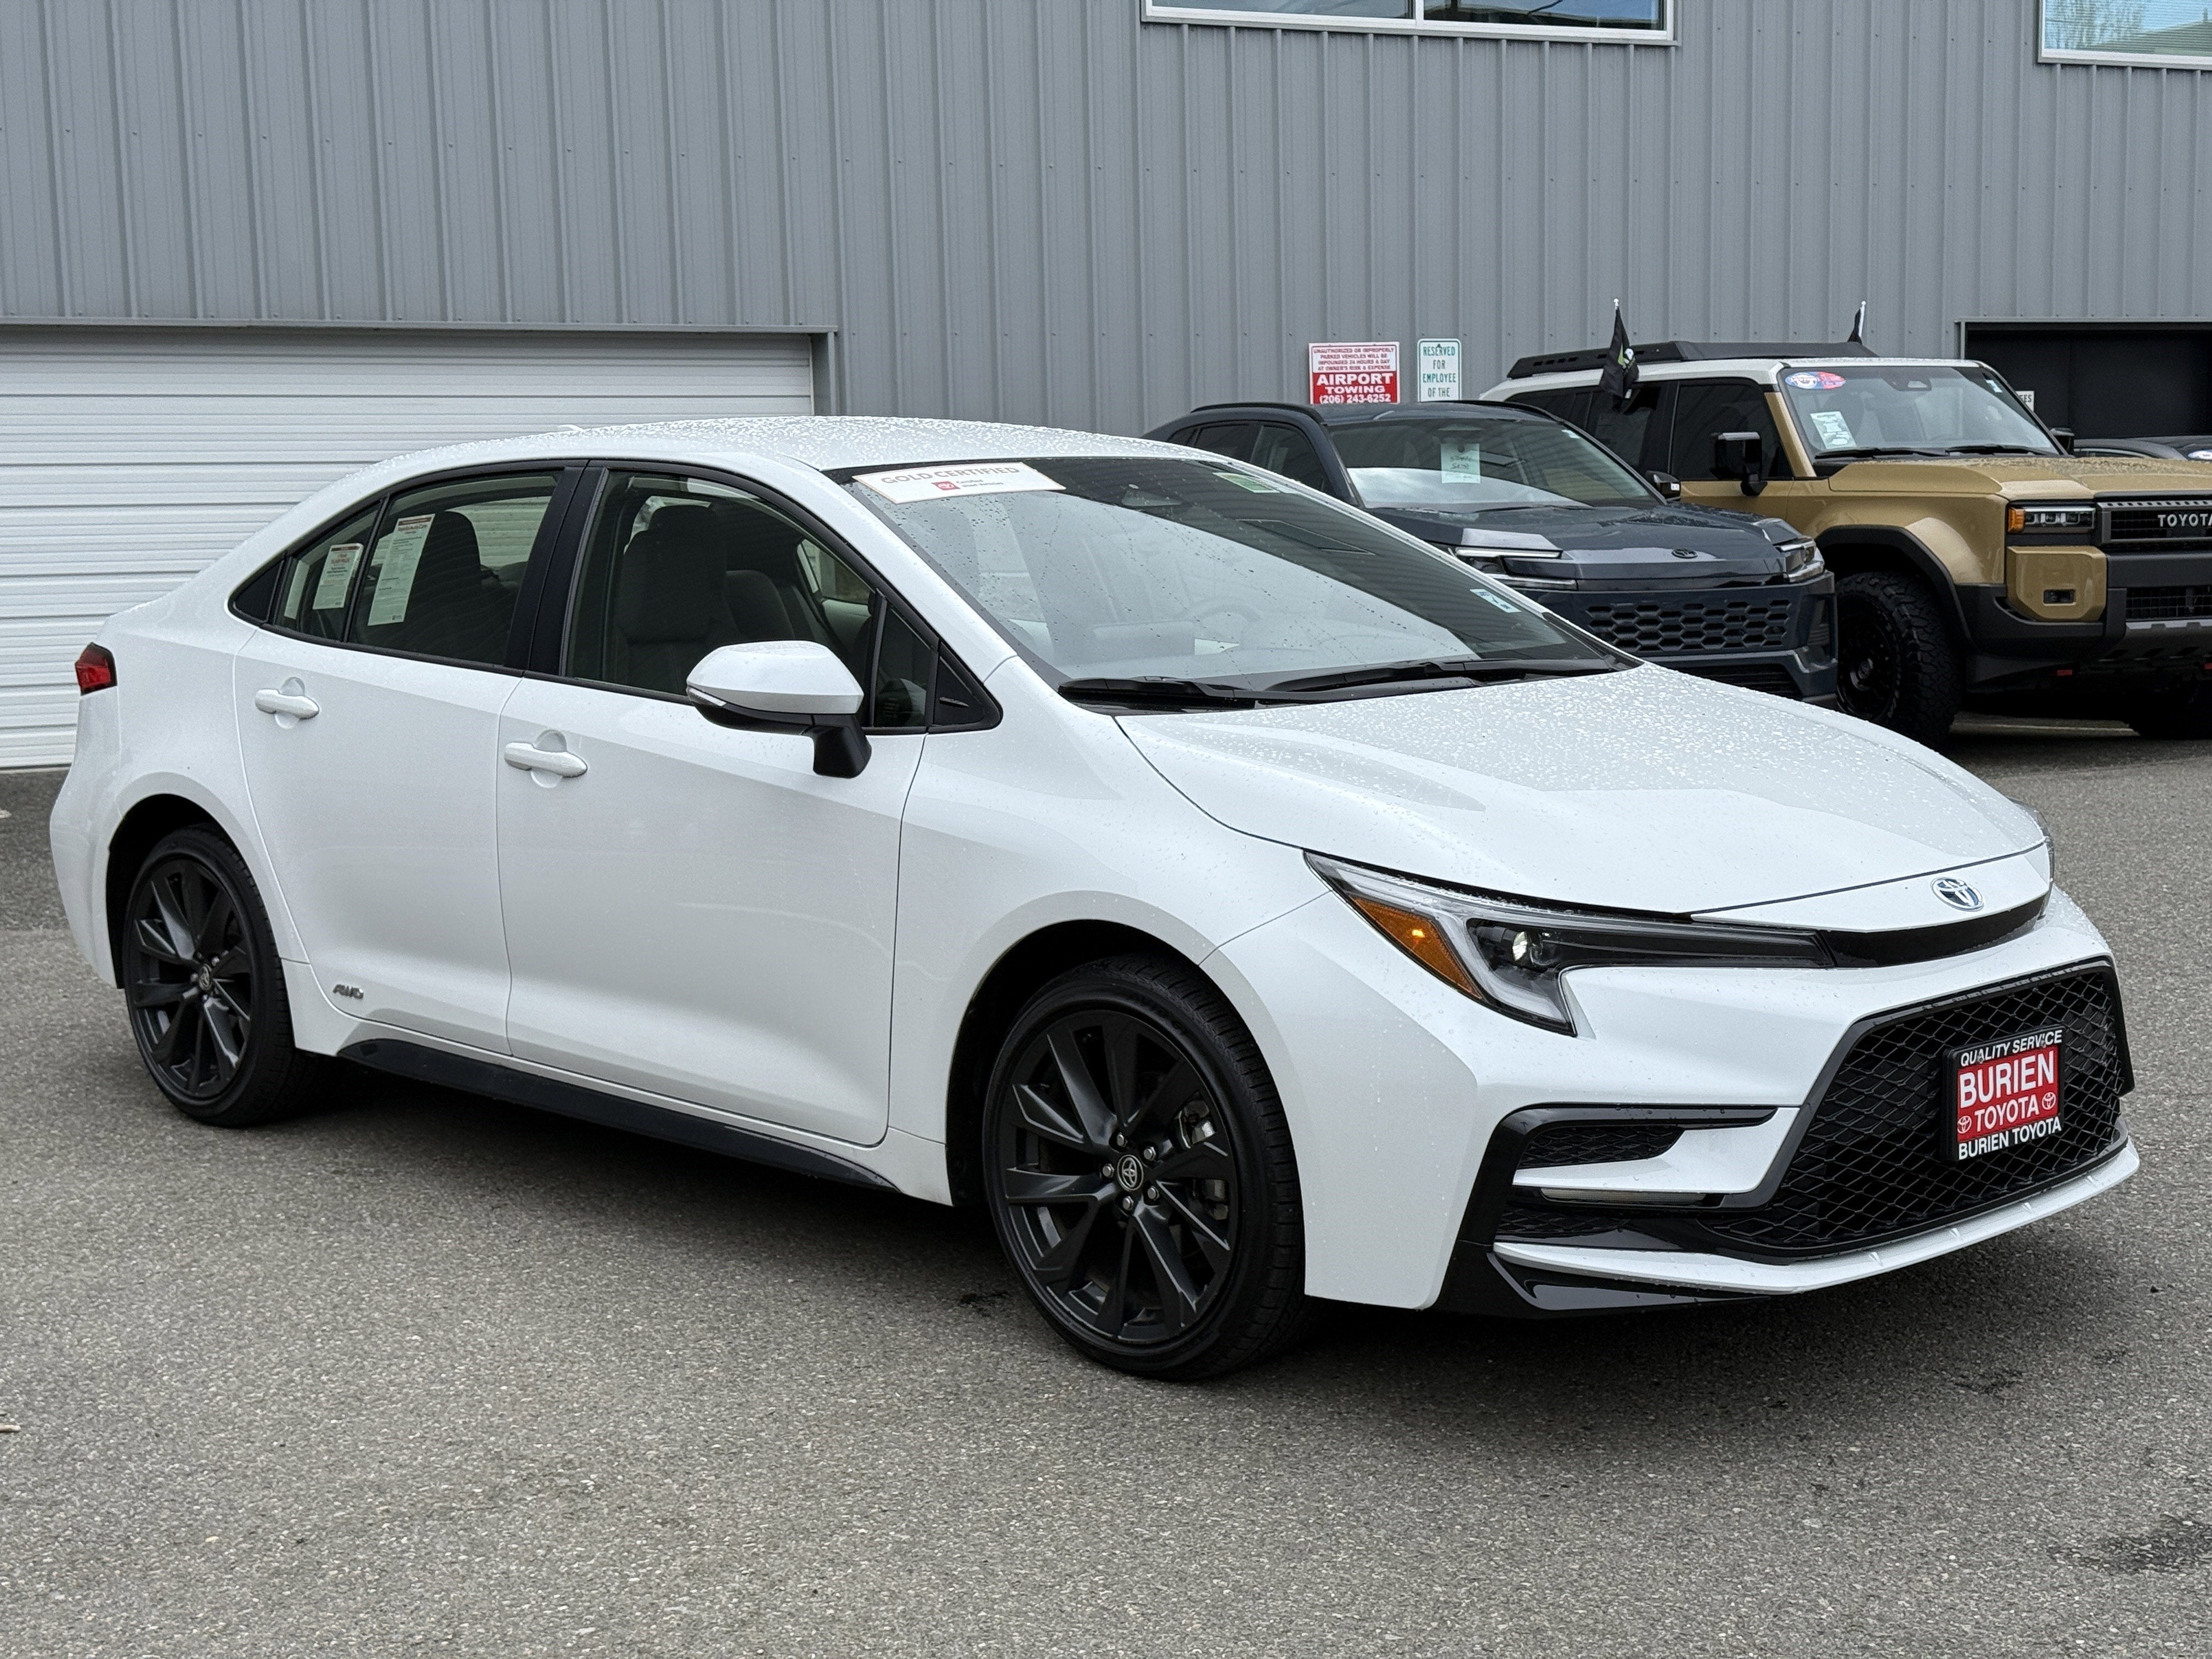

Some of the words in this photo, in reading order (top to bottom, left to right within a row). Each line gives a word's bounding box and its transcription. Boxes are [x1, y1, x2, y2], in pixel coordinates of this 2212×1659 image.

[1423, 346, 1455, 356] RESERVED
[1433, 359, 1446, 369] FOR
[1317, 373, 1393, 386] AIRPORT
[1423, 373, 1457, 383] EMPLOYEE
[1325, 386, 1386, 394] TOWING
[1427, 387, 1436, 397] OF
[1438, 387, 1450, 397] THE
[1319, 395, 1344, 404] (206)
[881, 473, 933, 484] GOLD
[934, 467, 1020, 477] CERTIFIED
[1961, 1042, 2011, 1067] QUALITY
[1960, 1051, 2055, 1108] BURIEN
[1974, 1094, 2040, 1132] TOYOTA
[1959, 1130, 2008, 1160] BURIEN
[2012, 1116, 2062, 1144] TOYOTA
